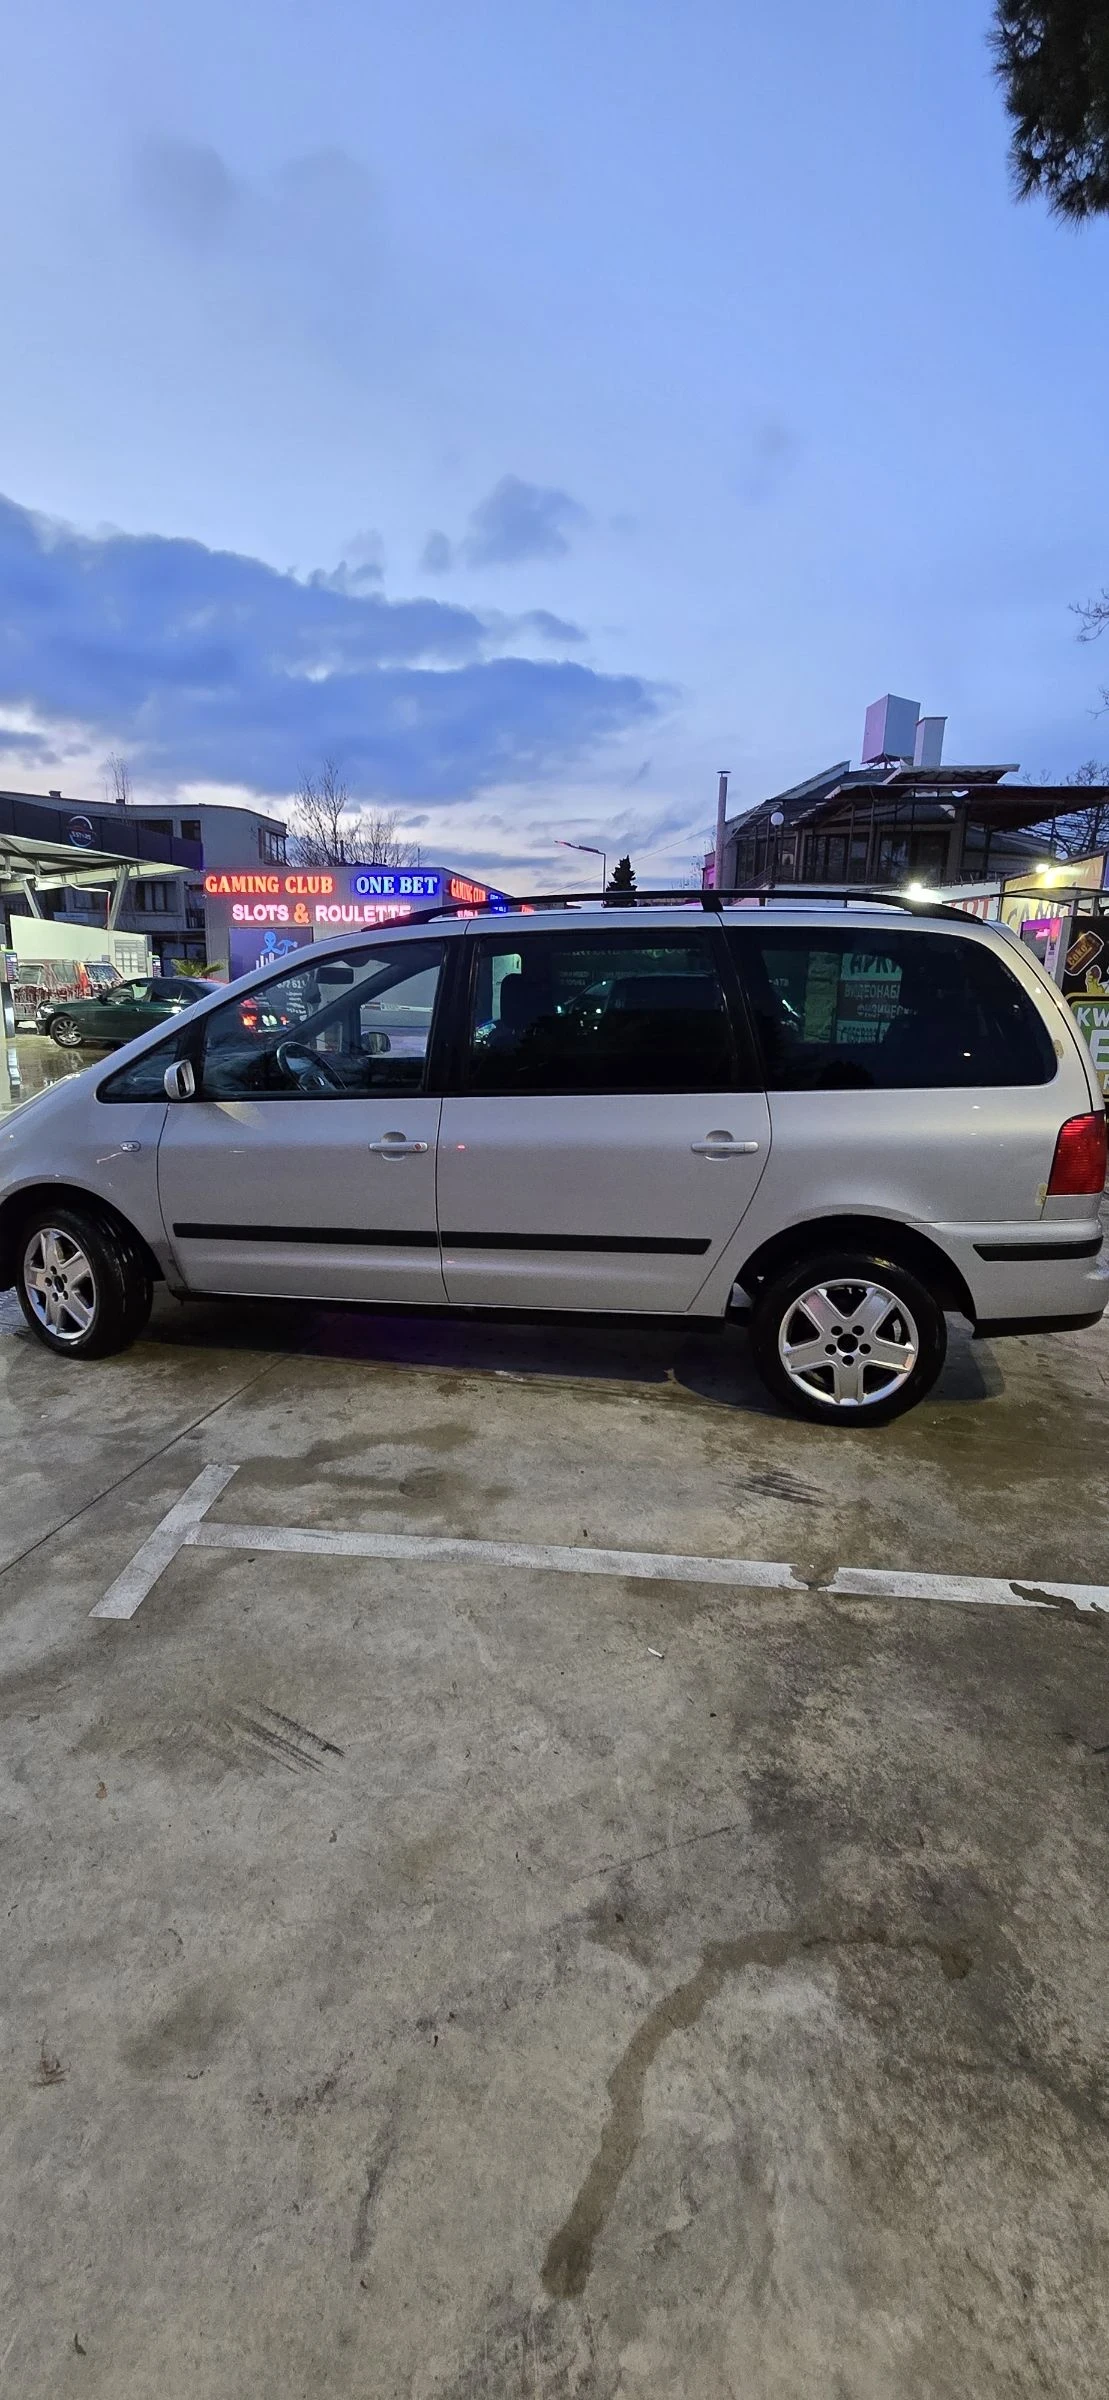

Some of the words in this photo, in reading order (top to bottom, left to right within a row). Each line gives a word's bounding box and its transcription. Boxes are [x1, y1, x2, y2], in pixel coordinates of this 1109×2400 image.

[205, 876, 279, 893] GAMING
[284, 876, 333, 893] CLUB
[356, 877, 394, 893] ONE
[399, 876, 438, 893] BET
[232, 904, 289, 921] SLOTS
[293, 903, 310, 923] &
